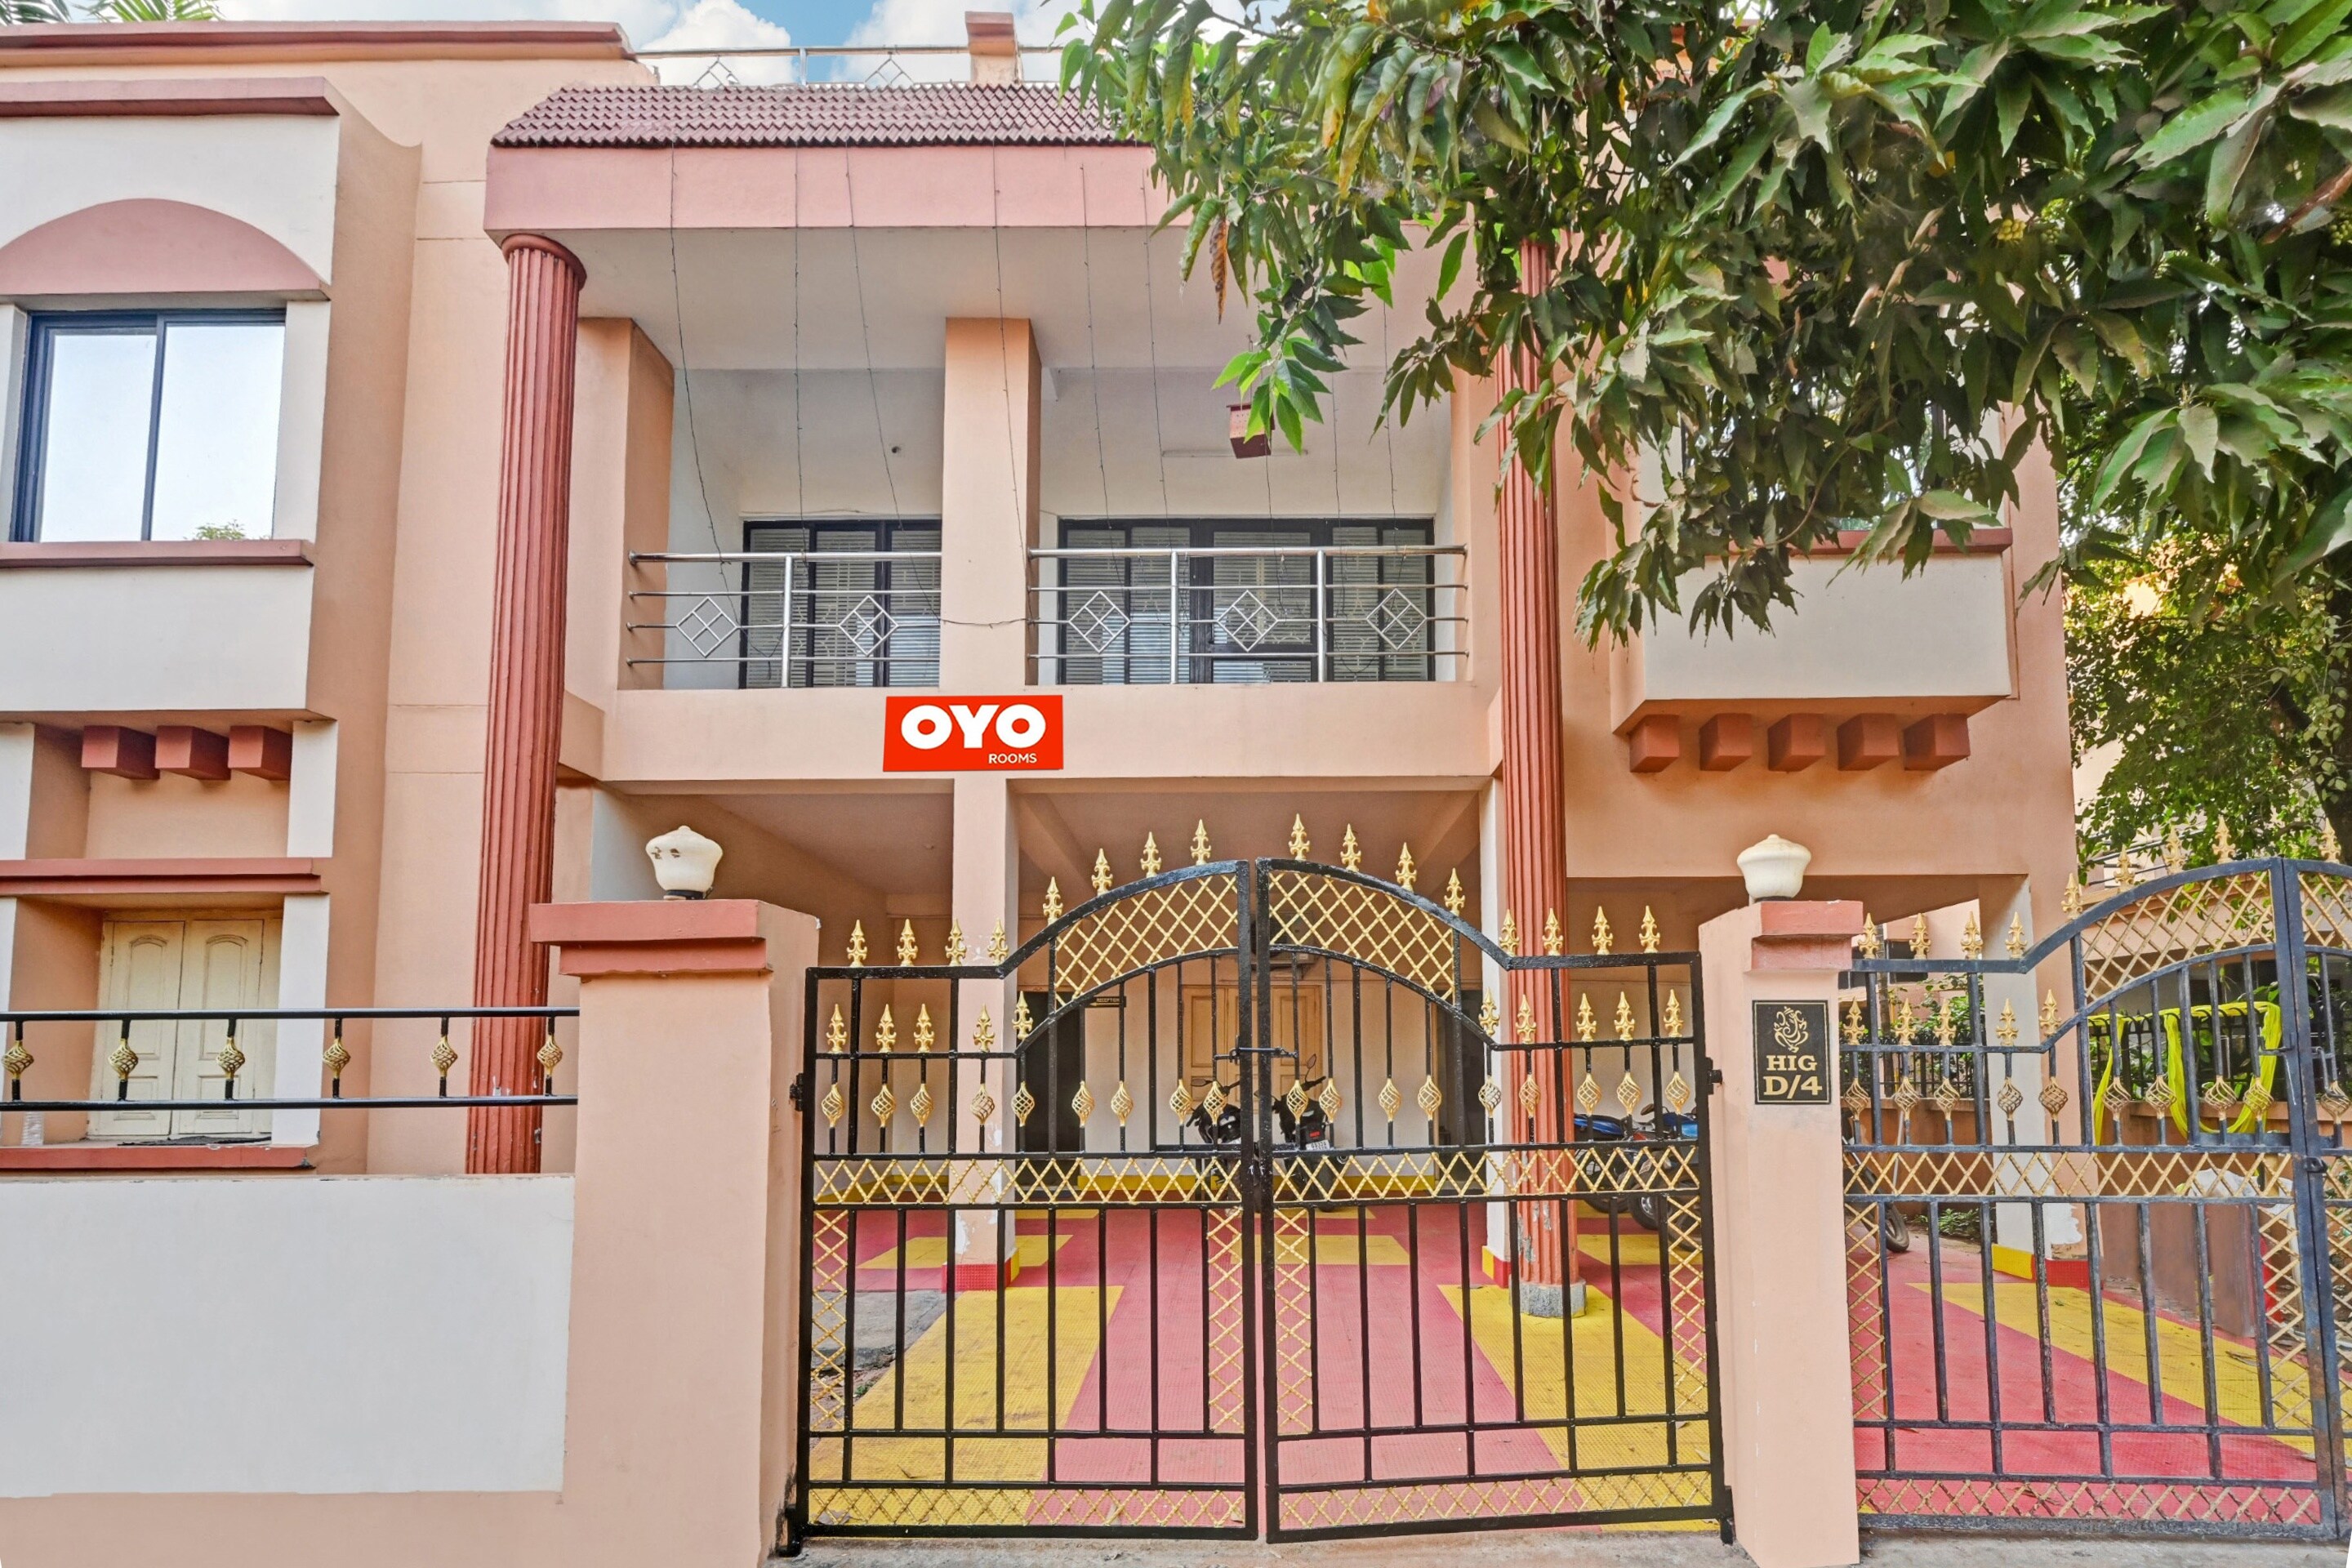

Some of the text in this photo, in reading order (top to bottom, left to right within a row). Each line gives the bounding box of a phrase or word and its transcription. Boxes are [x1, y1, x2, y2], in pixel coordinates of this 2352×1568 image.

[901, 704, 1046, 750] OYO
[988, 753, 1037, 764] ROOMS
[1766, 1055, 1818, 1071] HIG
[1762, 1074, 1823, 1099] D/4
